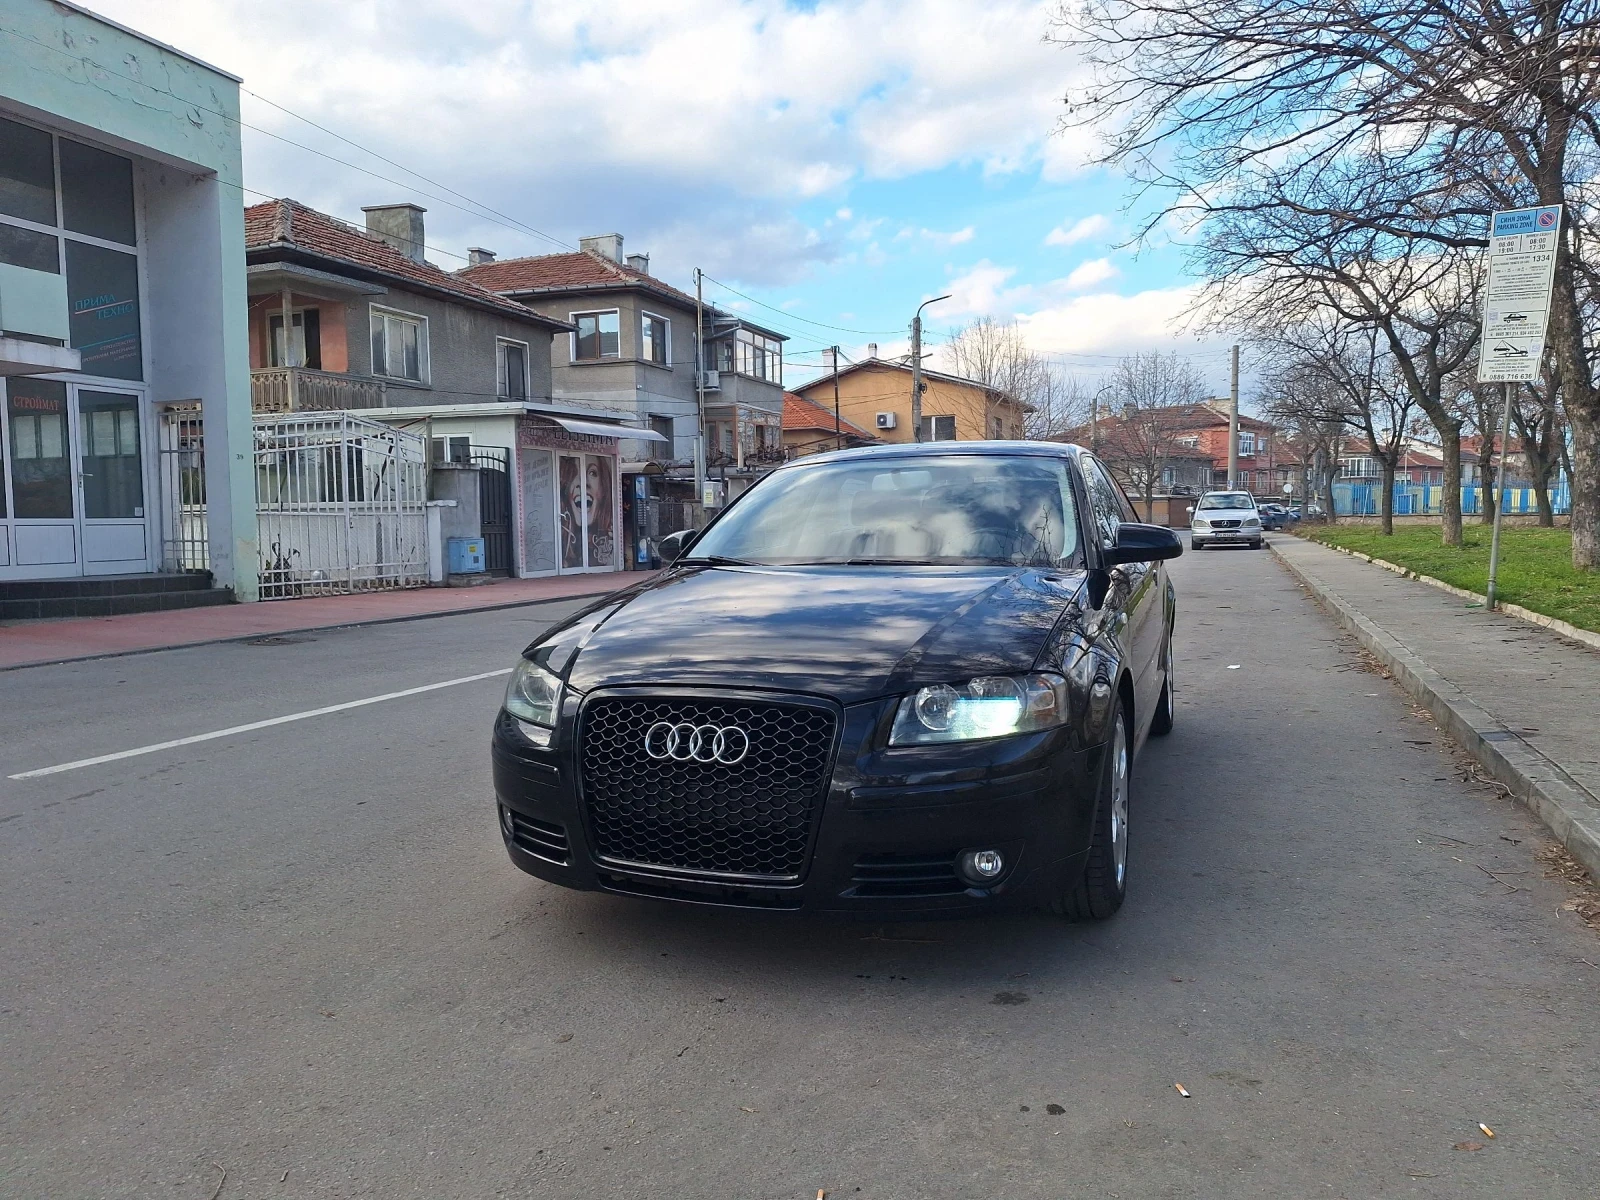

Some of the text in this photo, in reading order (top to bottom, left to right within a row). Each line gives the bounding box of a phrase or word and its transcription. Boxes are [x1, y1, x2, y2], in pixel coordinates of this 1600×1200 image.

[1496, 221, 1534, 231] PARKING ZONE
[1532, 254, 1550, 262] 1334
[75, 294, 116, 311] ПРИМА
[96, 303, 134, 320] ТЕХНО
[13, 395, 60, 411] СТРОЙМАТ
